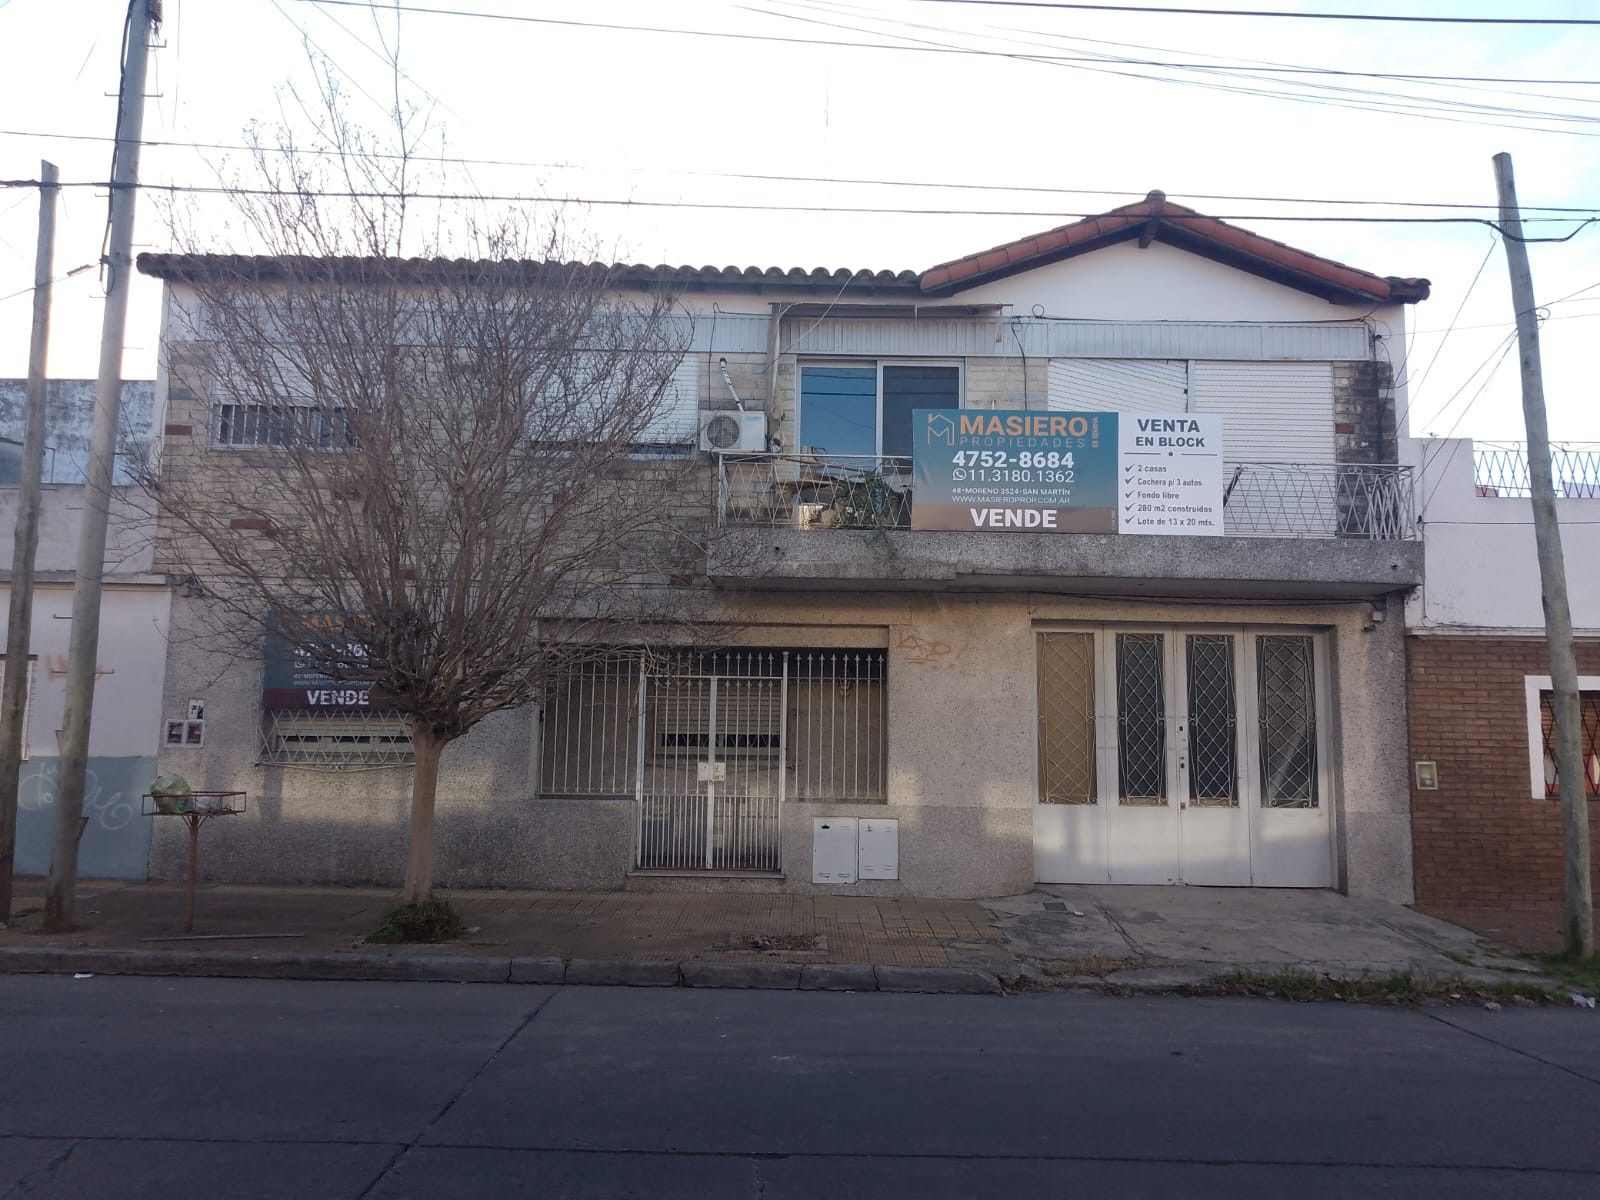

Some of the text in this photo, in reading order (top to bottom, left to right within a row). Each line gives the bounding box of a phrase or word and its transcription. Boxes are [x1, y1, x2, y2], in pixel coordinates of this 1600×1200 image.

[960, 415, 1088, 437] MASIERO
[1137, 418, 1200, 433] VENTA
[960, 436, 1085, 449] PROPIEDADES
[1135, 436, 1206, 448] EN BLOCK
[952, 450, 1075, 469] 4752-8684
[1137, 464, 1143, 472] 2
[968, 469, 1075, 483] 11.3180.1362
[1137, 478, 1167, 486] Cochera
[1176, 478, 1181, 486] 3
[1182, 479, 1203, 487] autos
[1137, 491, 1180, 500] Fondo libre
[1137, 504, 1213, 513] 280 m2 construidos
[970, 508, 1058, 528] VENDE
[1156, 518, 1166, 526] de
[1168, 518, 1178, 526] 13
[1186, 518, 1196, 526] 20
[1197, 518, 1216, 526] mts.
[306, 690, 370, 705] VENDE
